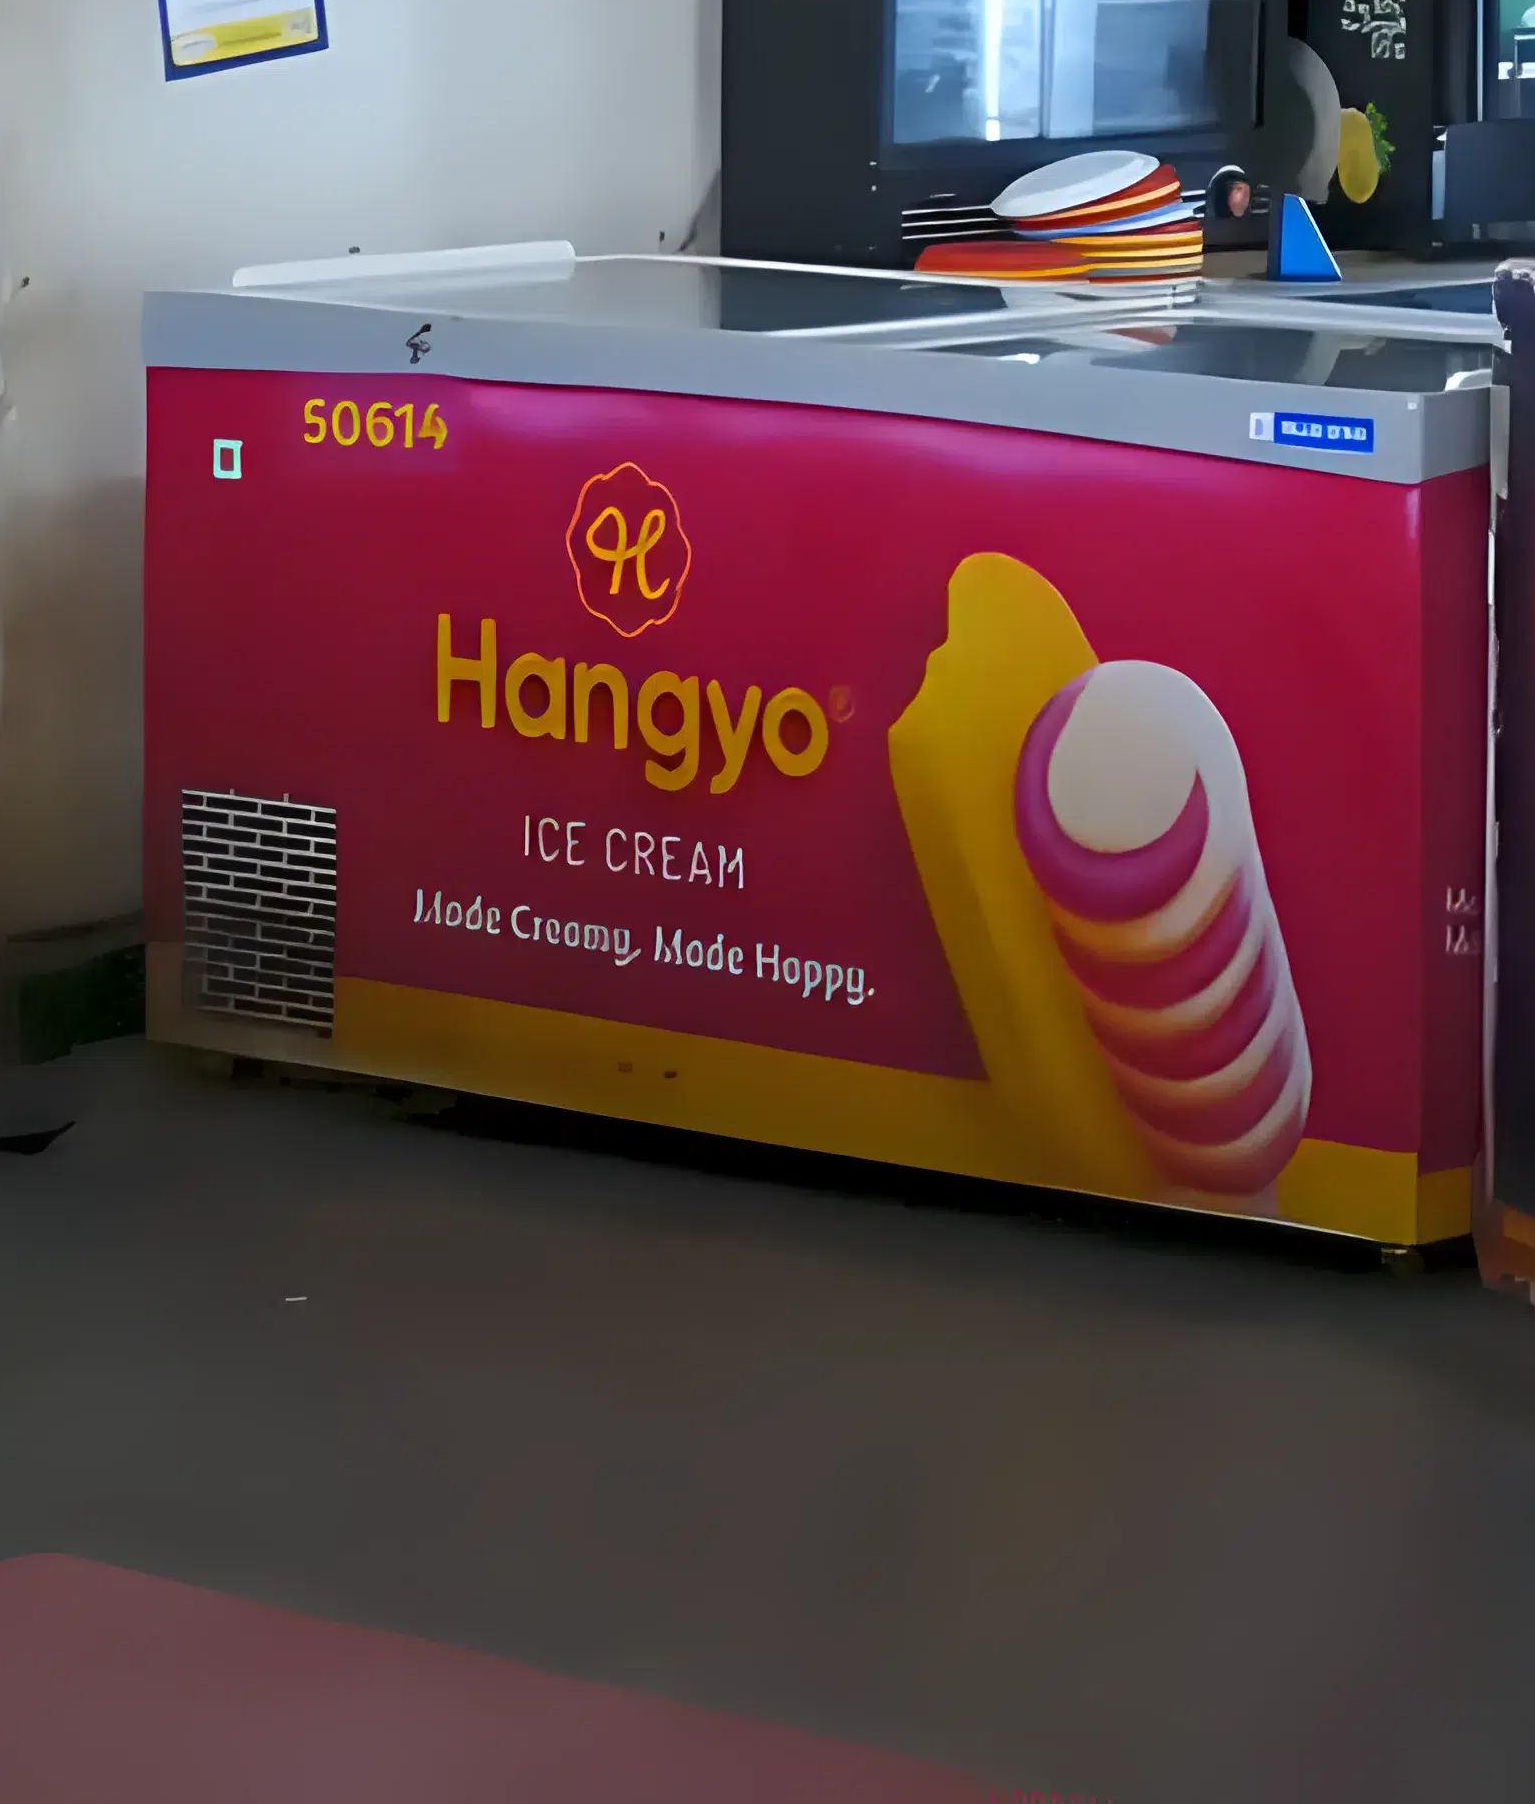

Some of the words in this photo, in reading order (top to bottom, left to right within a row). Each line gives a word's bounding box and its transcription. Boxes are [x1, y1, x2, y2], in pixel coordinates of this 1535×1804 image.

[303, 399, 448, 450] 50614
[437, 613, 829, 794] Hangyo
[523, 814, 585, 866] ICE
[605, 828, 745, 889] CREAM
